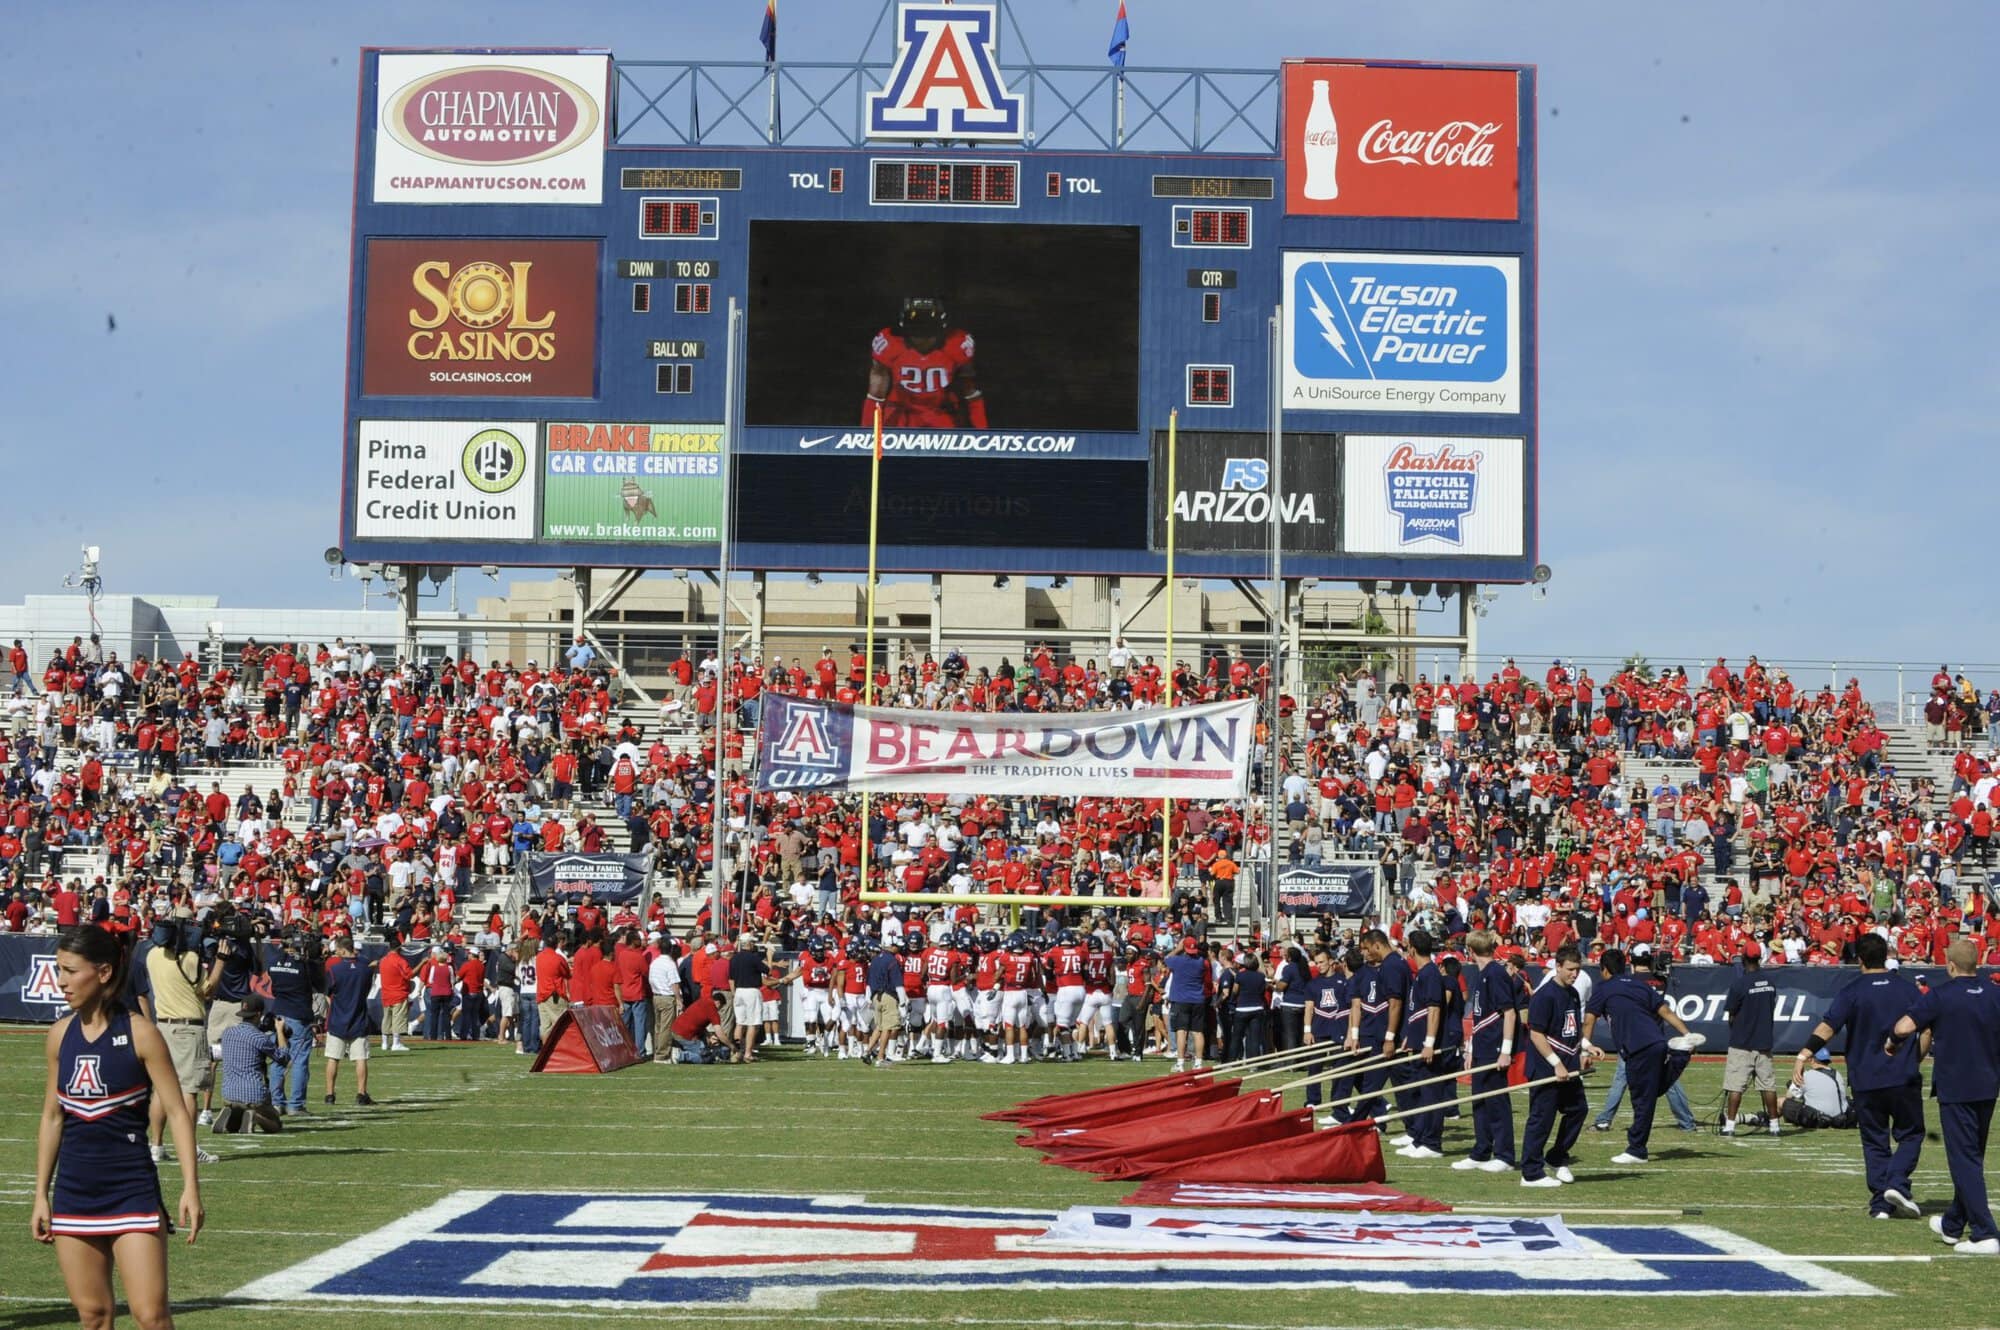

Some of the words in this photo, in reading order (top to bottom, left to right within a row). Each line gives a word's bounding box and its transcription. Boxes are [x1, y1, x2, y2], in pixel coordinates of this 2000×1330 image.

[866, 3, 1024, 138] A
[419, 90, 560, 127] CHAPMAN
[423, 128, 557, 142] AUTOMOTIVE
[1358, 119, 1504, 167] Coca-Cola
[390, 175, 587, 191] CHAPMANTUCSON.COM
[789, 173, 824, 188] TOL
[1067, 178, 1102, 193] TOL
[629, 261, 654, 276] DWN
[676, 262, 691, 276] TO
[694, 262, 710, 277] GO
[1201, 270, 1223, 286] QTR
[408, 261, 556, 330] SOL
[1349, 277, 1458, 307] Tucson
[1359, 306, 1487, 336] Electric
[407, 331, 556, 361] CASINOS
[653, 342, 679, 357] BALL
[681, 342, 697, 357] ON
[1372, 336, 1487, 365] Power
[429, 371, 532, 384] SOLCASINOS.COM
[1293, 386, 1304, 399] A
[1308, 387, 1382, 400] UniSource
[1386, 388, 1435, 404] Energy
[1439, 389, 1507, 406] Company
[368, 440, 427, 459] Pima
[551, 454, 586, 473] CAR
[592, 454, 637, 474] CARE
[643, 455, 719, 475] CENTERS
[366, 469, 455, 490] Federal
[1221, 458, 1270, 491] FS
[1393, 476, 1469, 488] OFFICIAL
[1393, 489, 1469, 500] TAILGATE
[365, 501, 439, 520] Credit
[446, 501, 517, 520] Union
[550, 522, 717, 538] www.brakemax.com
[1406, 518, 1457, 528] ARIZONA
[770, 702, 839, 768] A
[971, 764, 998, 775] THE
[1003, 765, 1083, 777] TRADITION
[1089, 766, 1128, 778] LIVES
[555, 864, 594, 872] AMERICAN
[596, 864, 624, 873] FAMILY
[1280, 877, 1319, 885] AMERICAN
[928, 954, 949, 976] 26
[1061, 955, 1081, 974] 76
[66, 1055, 108, 1098] A
